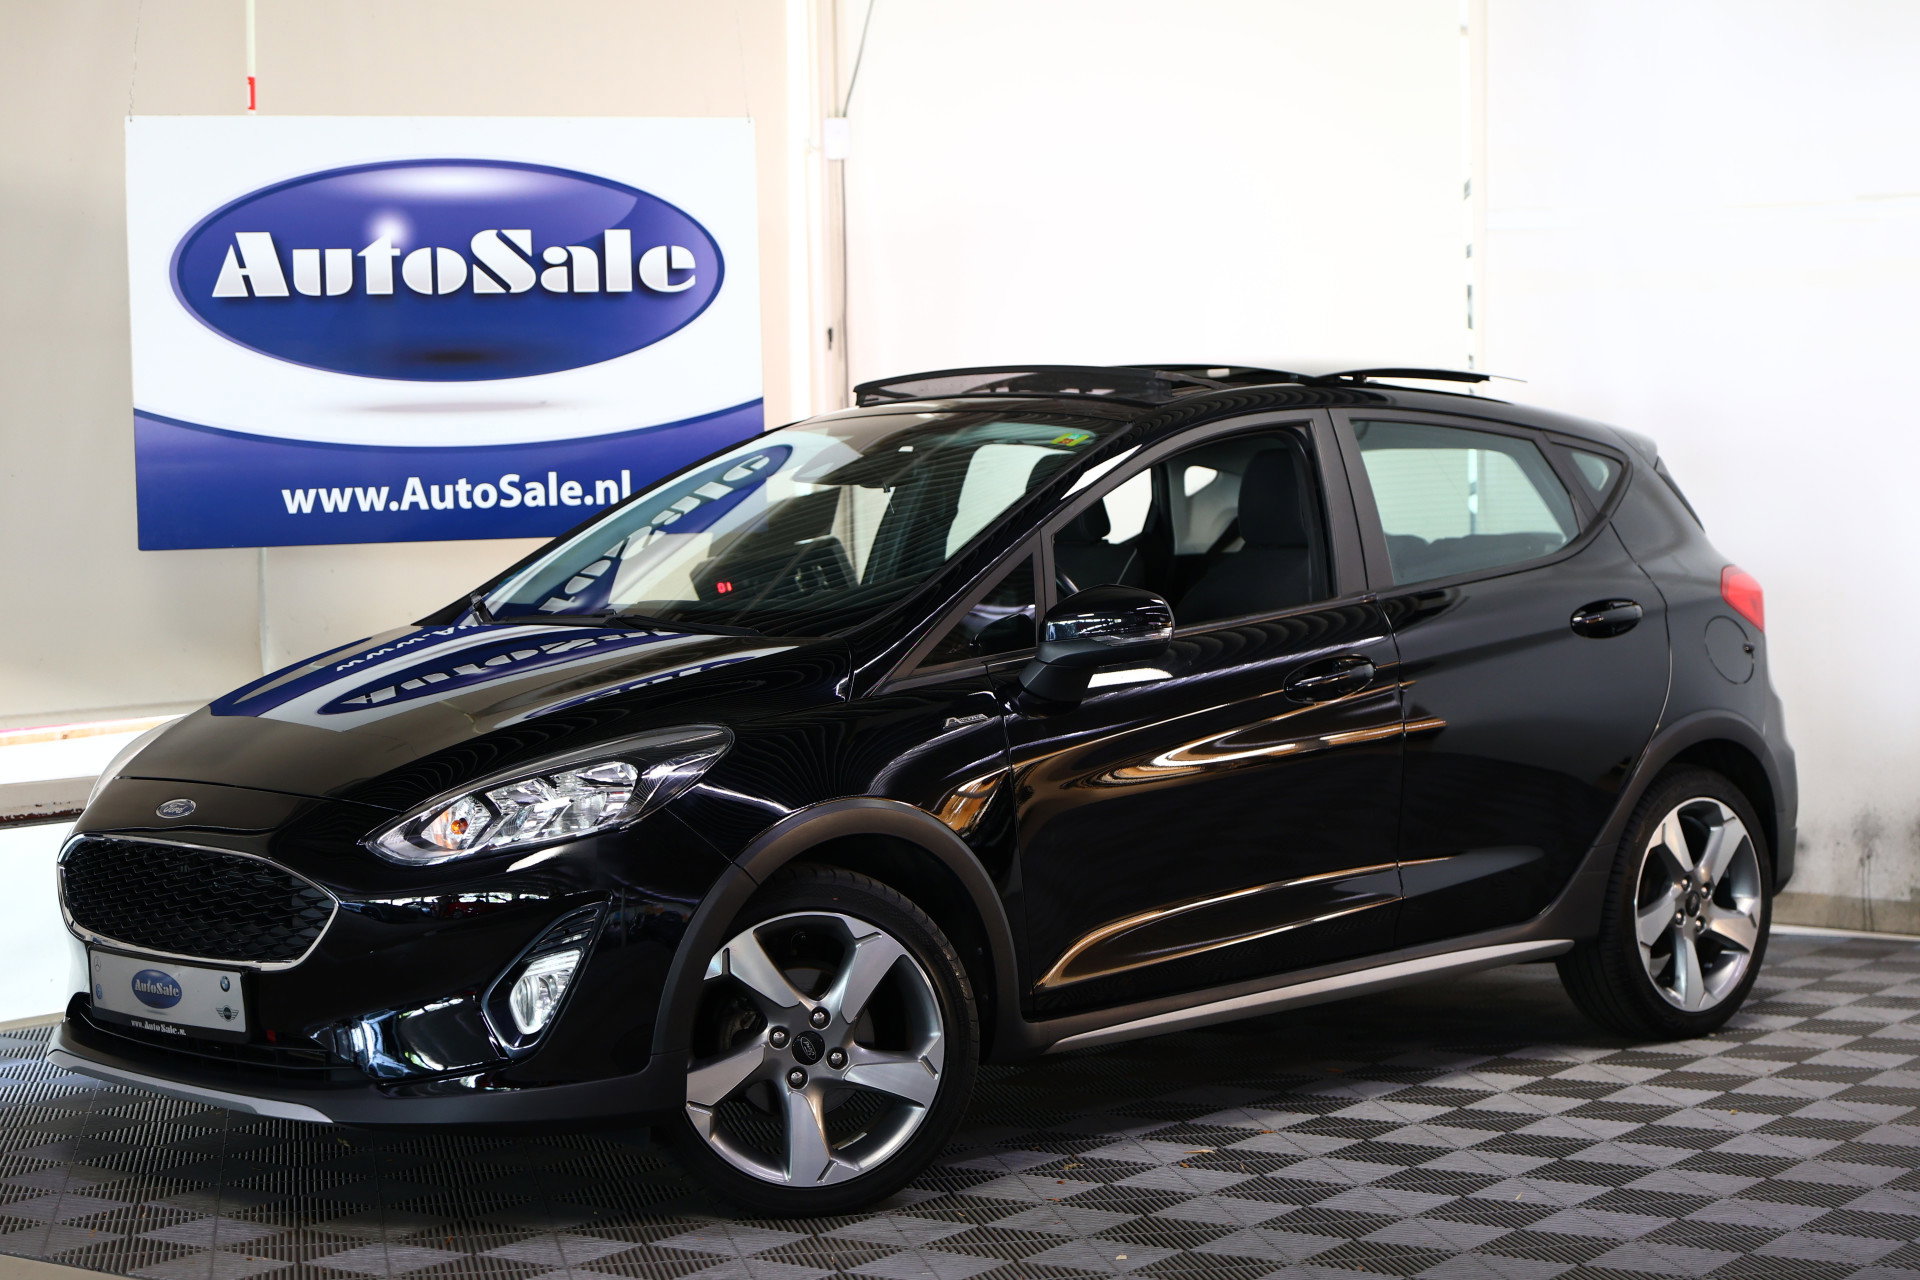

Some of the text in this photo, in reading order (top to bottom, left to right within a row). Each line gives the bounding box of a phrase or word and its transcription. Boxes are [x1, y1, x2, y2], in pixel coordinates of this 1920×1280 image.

[211, 228, 697, 298] AutoSale
[281, 469, 632, 514] www.AutoSale.nl
[134, 979, 180, 997] AutoSale
